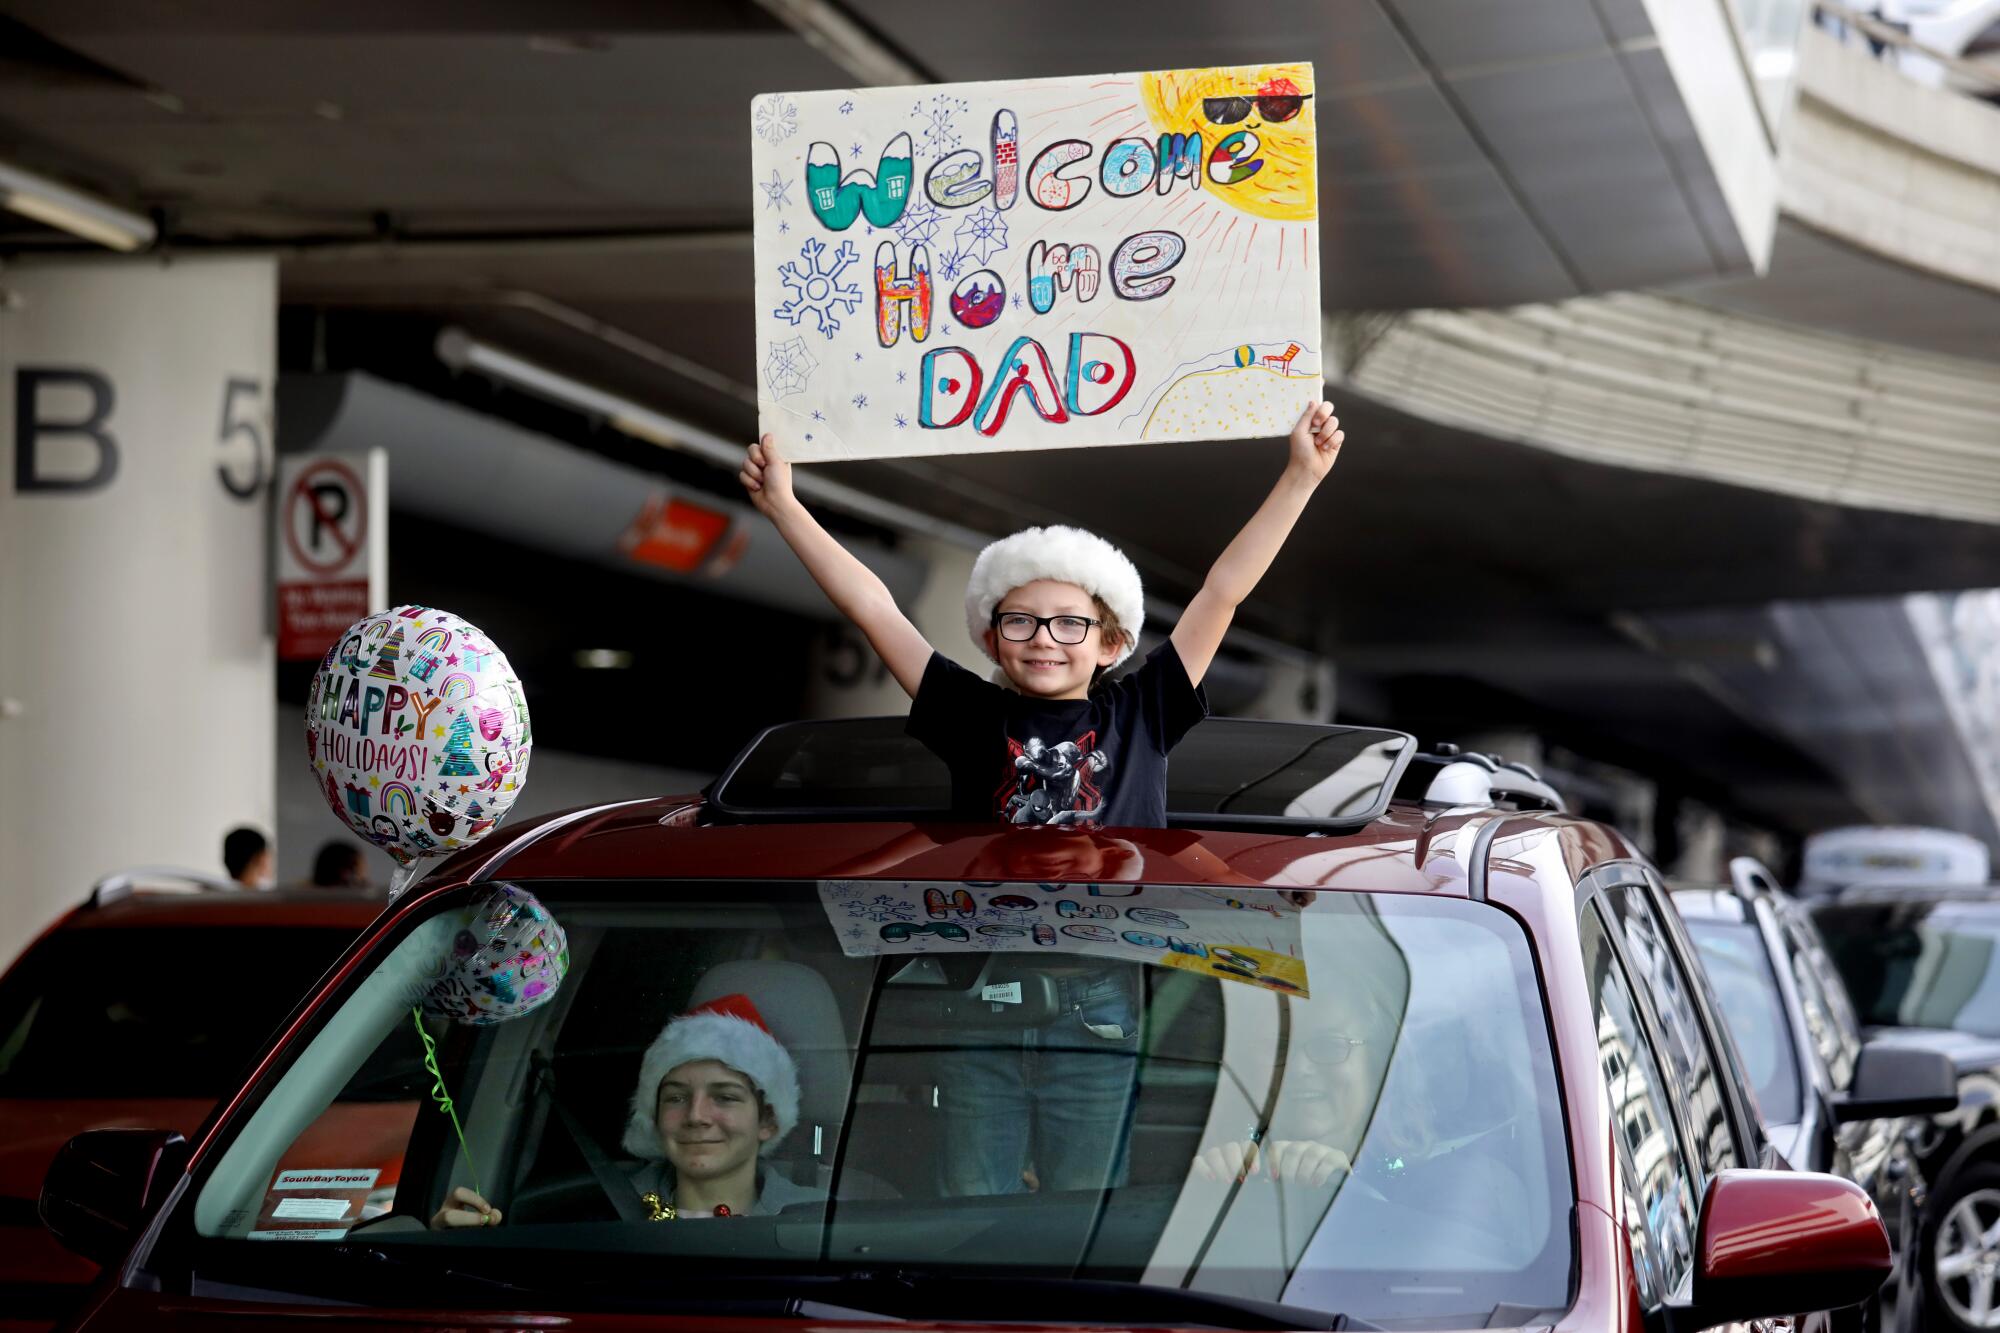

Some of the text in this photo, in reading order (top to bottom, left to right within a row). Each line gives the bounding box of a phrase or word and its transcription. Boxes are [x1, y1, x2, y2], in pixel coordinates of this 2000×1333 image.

[805, 108, 1264, 231] Welcome
[874, 230, 1186, 348] Home
[14, 364, 121, 496] B
[216, 375, 265, 501] 5
[918, 332, 1137, 437] DAD
[320, 673, 442, 740] HAPPY
[322, 726, 428, 781] HOLIDAYS!
